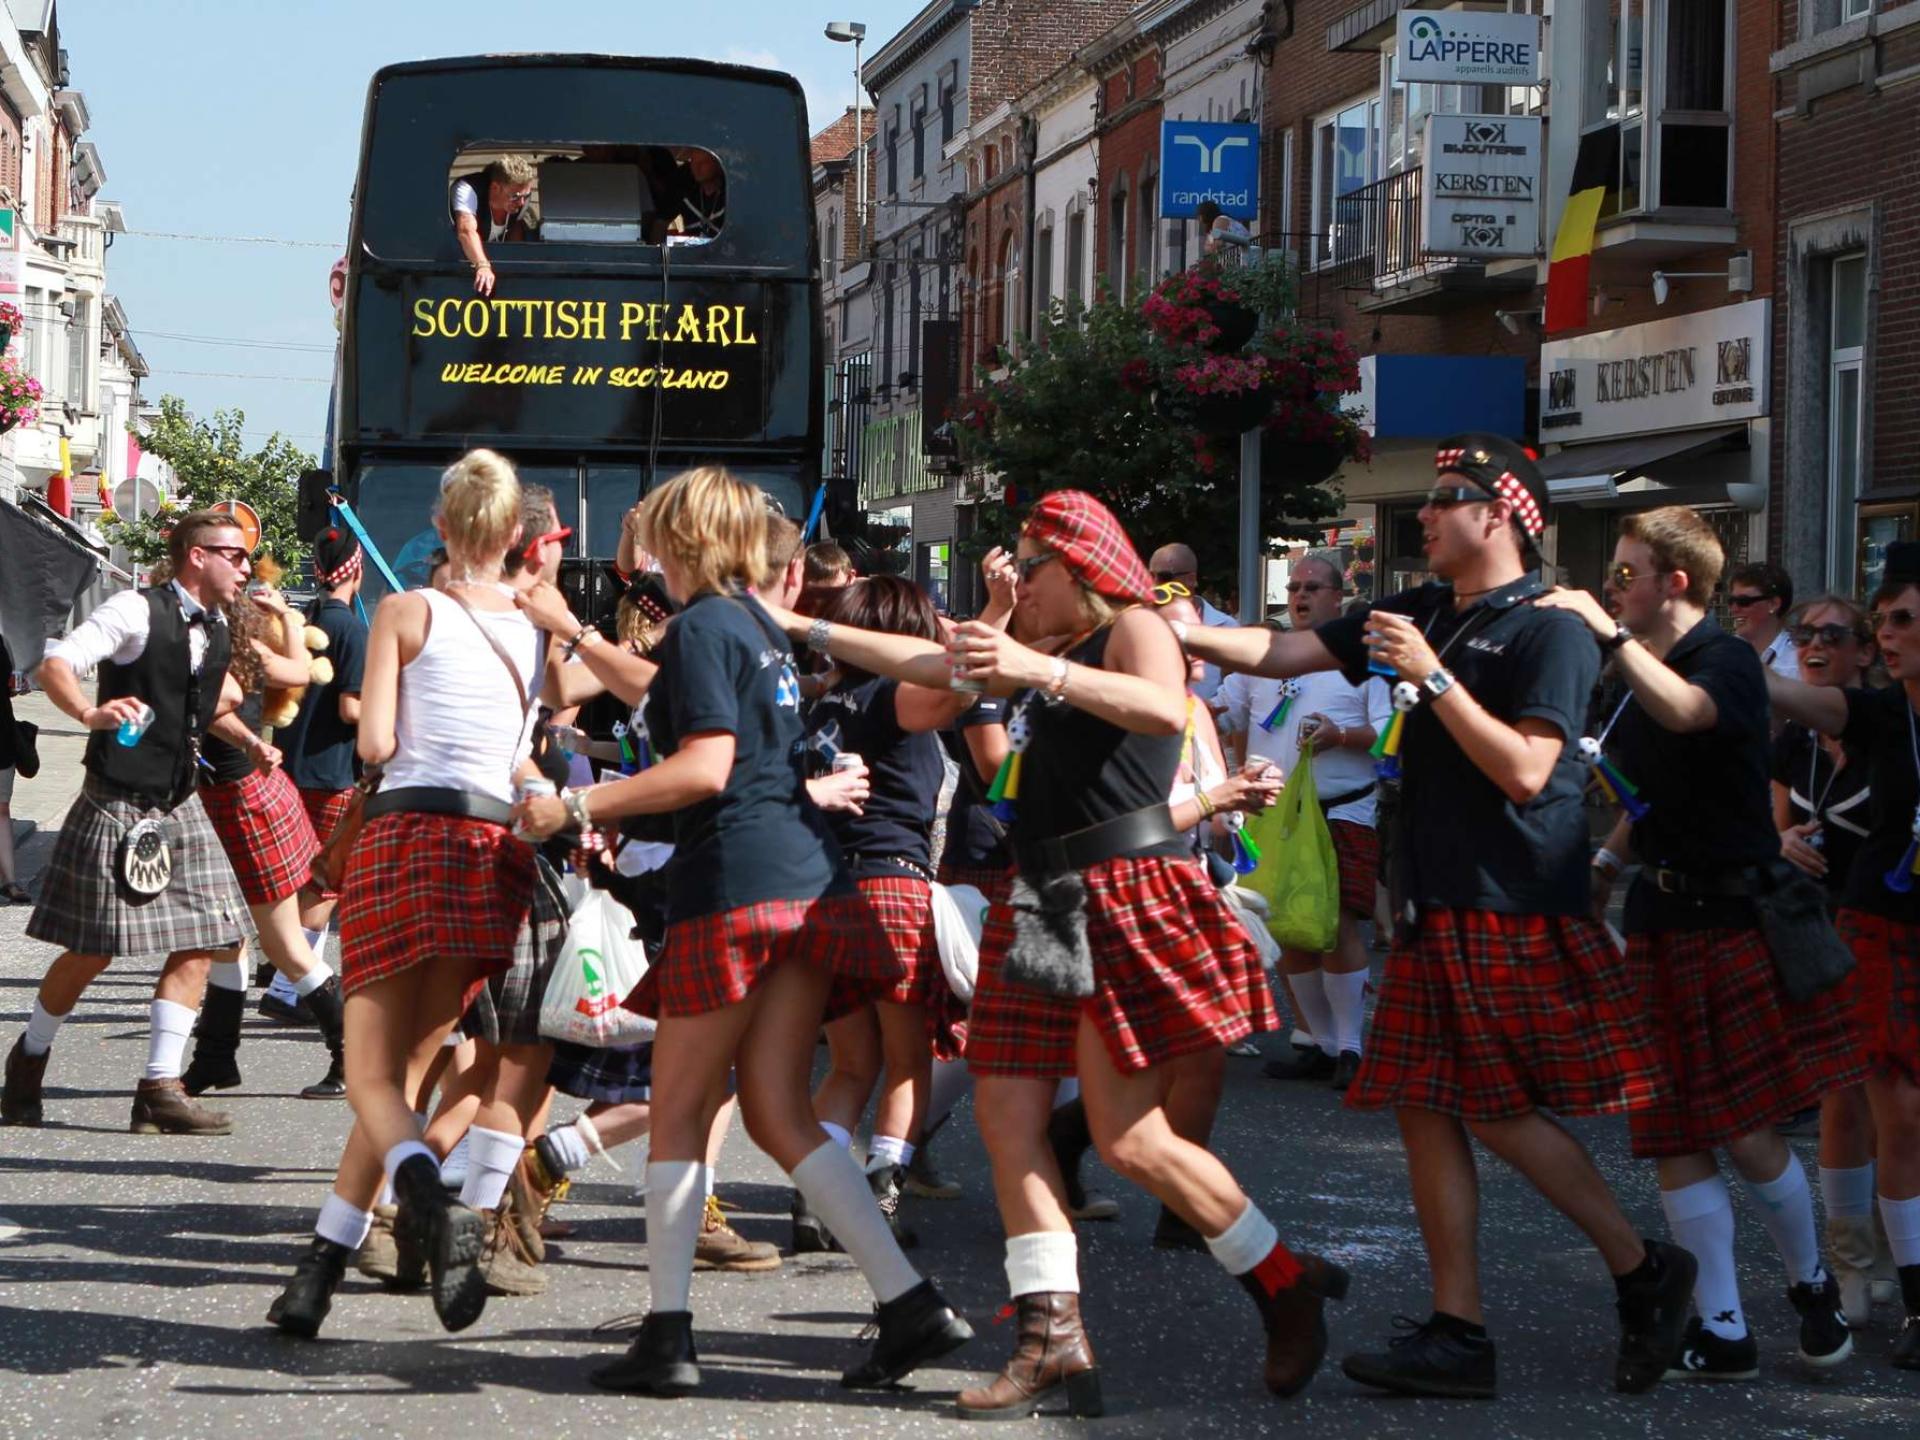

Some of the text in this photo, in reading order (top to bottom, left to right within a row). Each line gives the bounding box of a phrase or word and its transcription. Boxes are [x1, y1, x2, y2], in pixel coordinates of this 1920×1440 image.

[1409, 40, 1529, 65] LAPPERRE
[1435, 173, 1533, 195] KERSTEN
[1172, 188, 1248, 206] randstad
[412, 299, 757, 347] SCOTTISH PEARL
[441, 363, 566, 385] WELCOME
[573, 366, 604, 386] IN
[1597, 347, 1697, 402] KERSTEN
